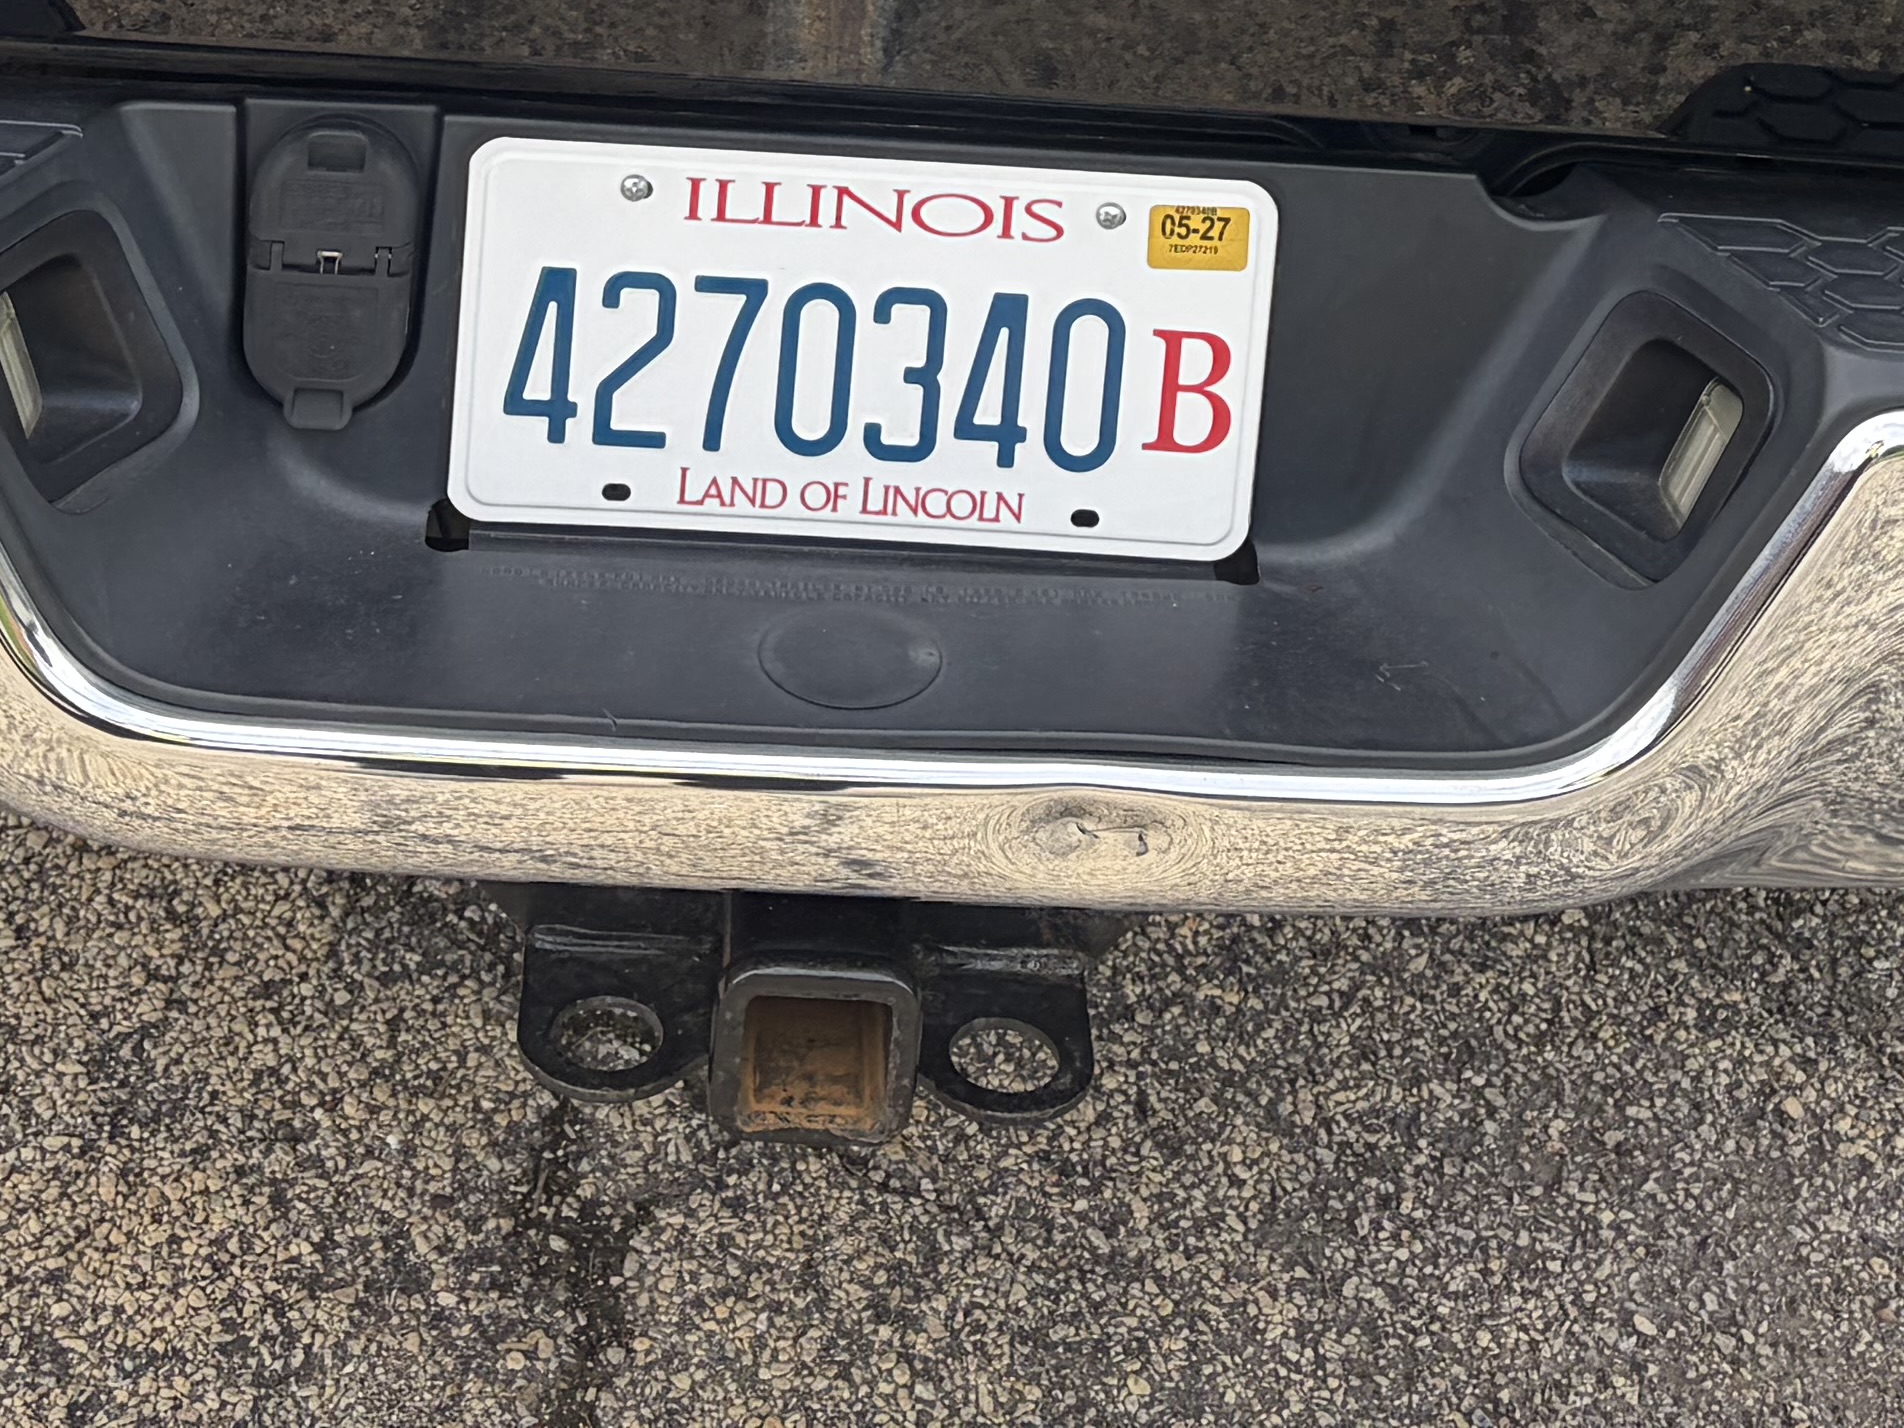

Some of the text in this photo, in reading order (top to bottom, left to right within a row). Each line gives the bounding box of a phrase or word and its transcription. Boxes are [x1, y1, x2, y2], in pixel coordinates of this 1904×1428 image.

[683, 176, 1067, 244] ILLINOIS
[1161, 213, 1232, 242] 05-27
[502, 266, 1233, 474] 4270340 B
[676, 466, 789, 511] LAND
[860, 476, 1026, 525] LINCOLN
